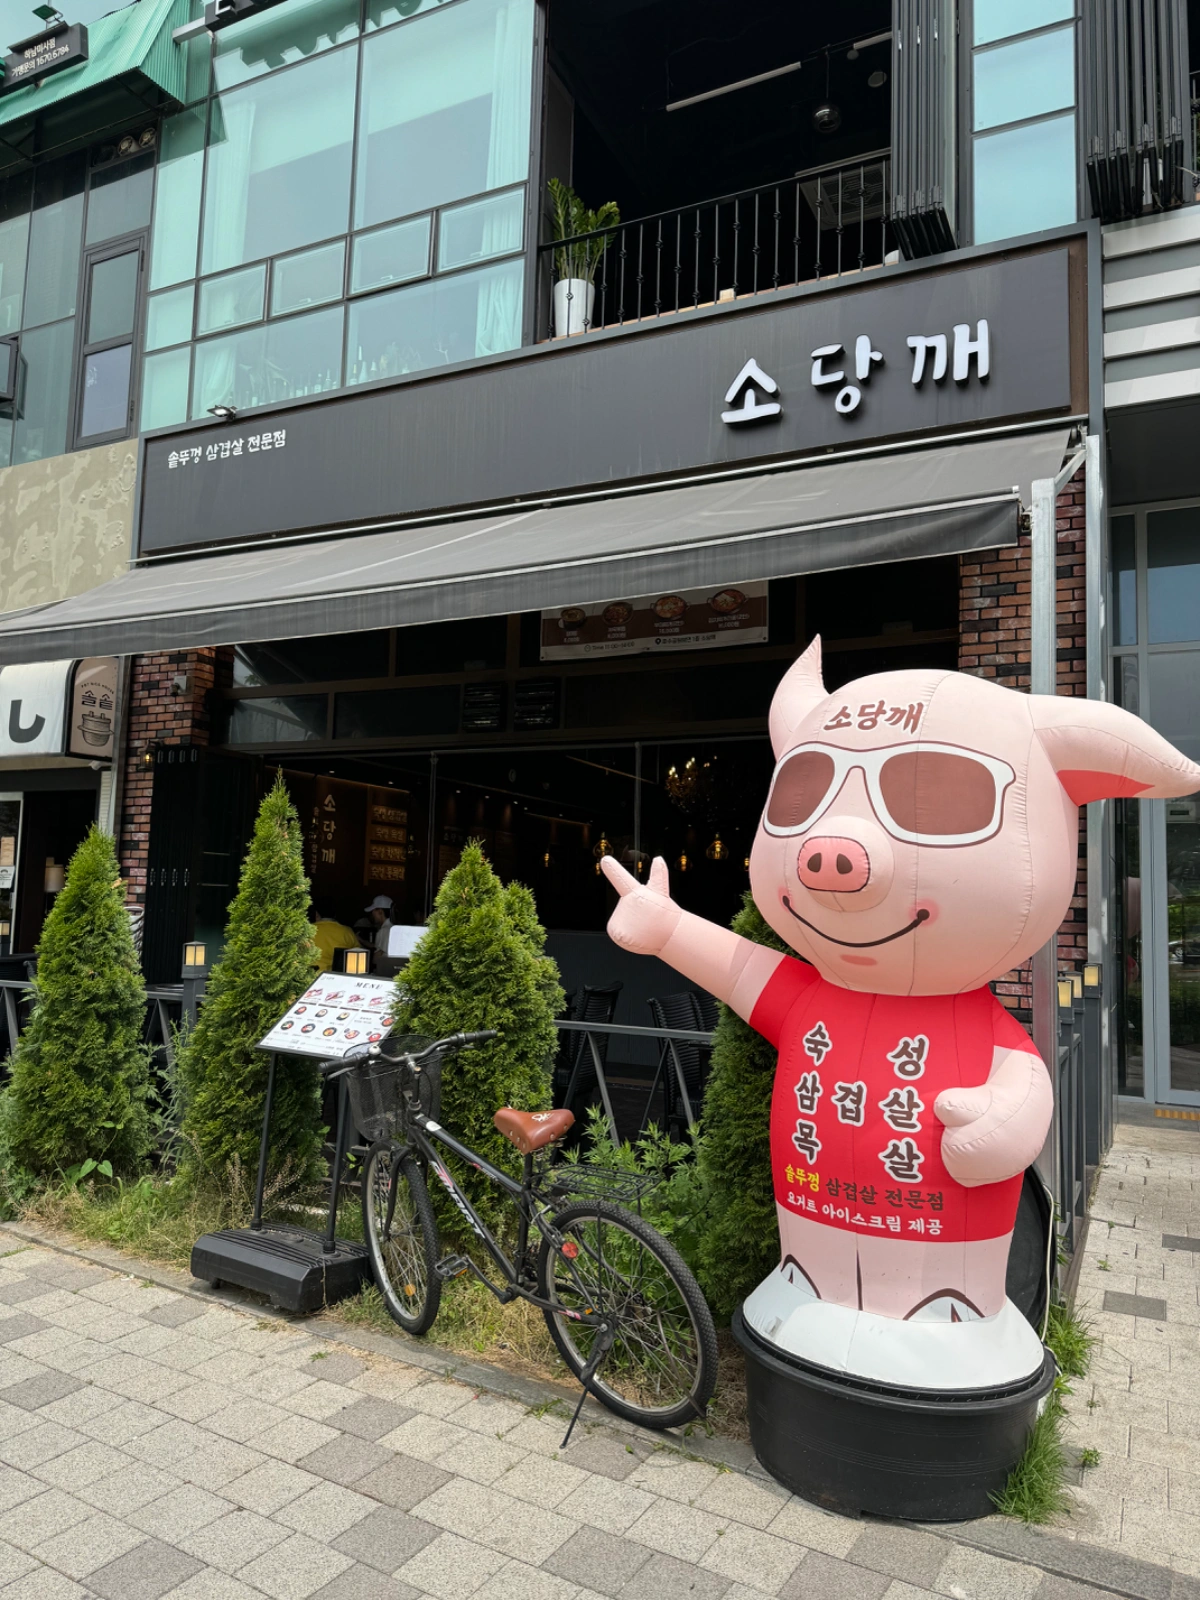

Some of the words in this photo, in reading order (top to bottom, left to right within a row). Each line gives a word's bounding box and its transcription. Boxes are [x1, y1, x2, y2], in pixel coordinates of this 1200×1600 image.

[721, 319, 991, 425] 소당깨
[168, 446, 202, 469] 솥뚜껑
[206, 438, 244, 461] 삼겹살
[247, 429, 287, 453] 전문점
[822, 699, 924, 733] 소당깨
[322, 794, 337, 864] 소당깨
[355, 981, 384, 990] MENU
[785, 1163, 820, 1193] 솥뚜껑
[825, 1177, 878, 1207] 삼겹살
[884, 1189, 944, 1211] 전문점
[786, 1191, 818, 1215] 요거트
[822, 1203, 902, 1233] 아이스크림
[907, 1218, 944, 1235] 제공
